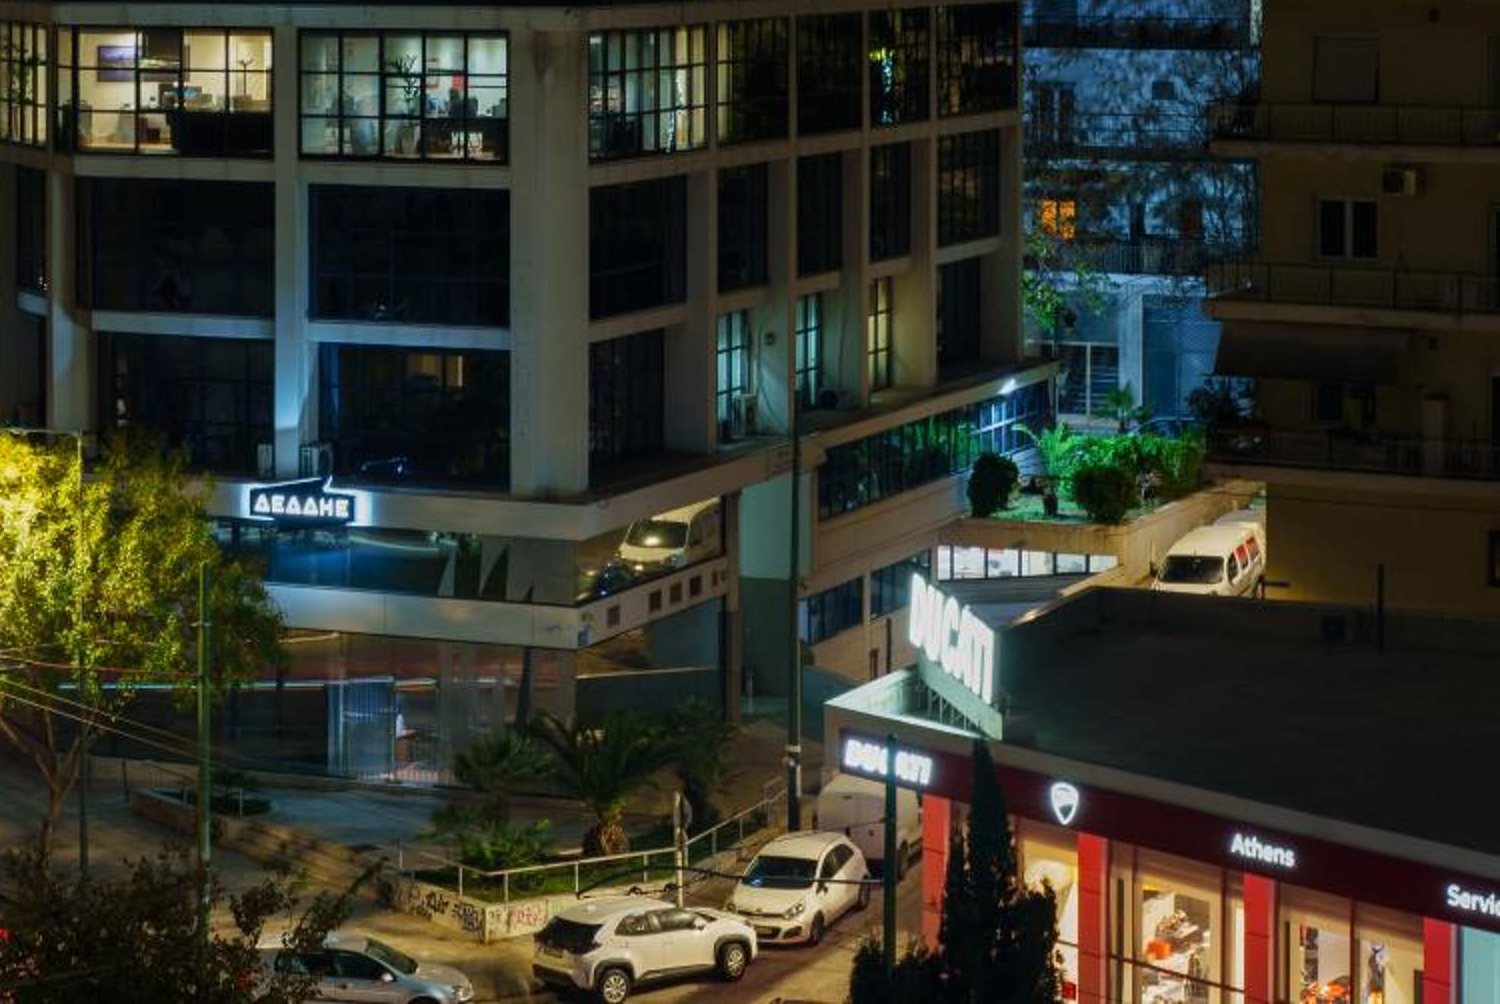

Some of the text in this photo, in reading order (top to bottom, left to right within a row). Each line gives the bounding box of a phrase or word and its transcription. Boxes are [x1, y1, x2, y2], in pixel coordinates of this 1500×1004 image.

[254, 493, 349, 518] ΔΕΔΔΗΕ
[909, 571, 995, 704] DUCATI
[1231, 833, 1296, 868] Athens
